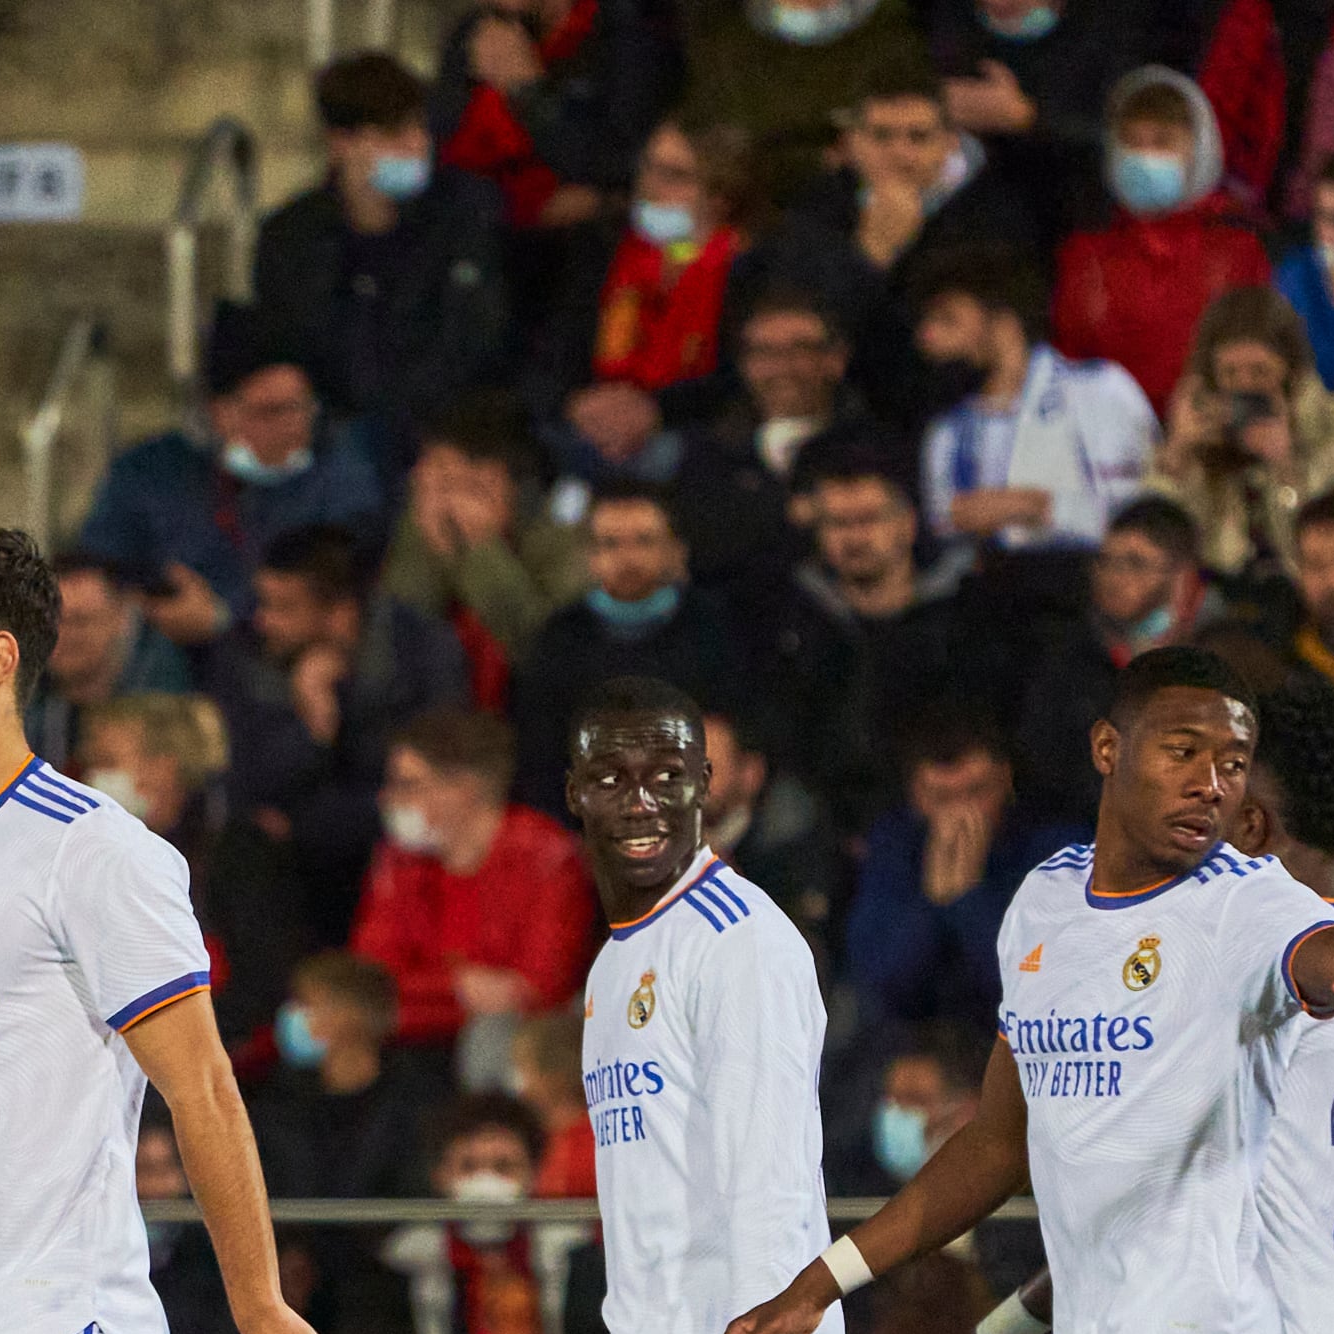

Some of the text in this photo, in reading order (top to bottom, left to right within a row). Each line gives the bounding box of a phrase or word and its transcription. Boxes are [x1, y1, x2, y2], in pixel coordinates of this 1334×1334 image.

[1005, 1009, 1154, 1054] Emirates
[585, 1059, 665, 1107] mirates
[1050, 1061, 1122, 1097] BETTER
